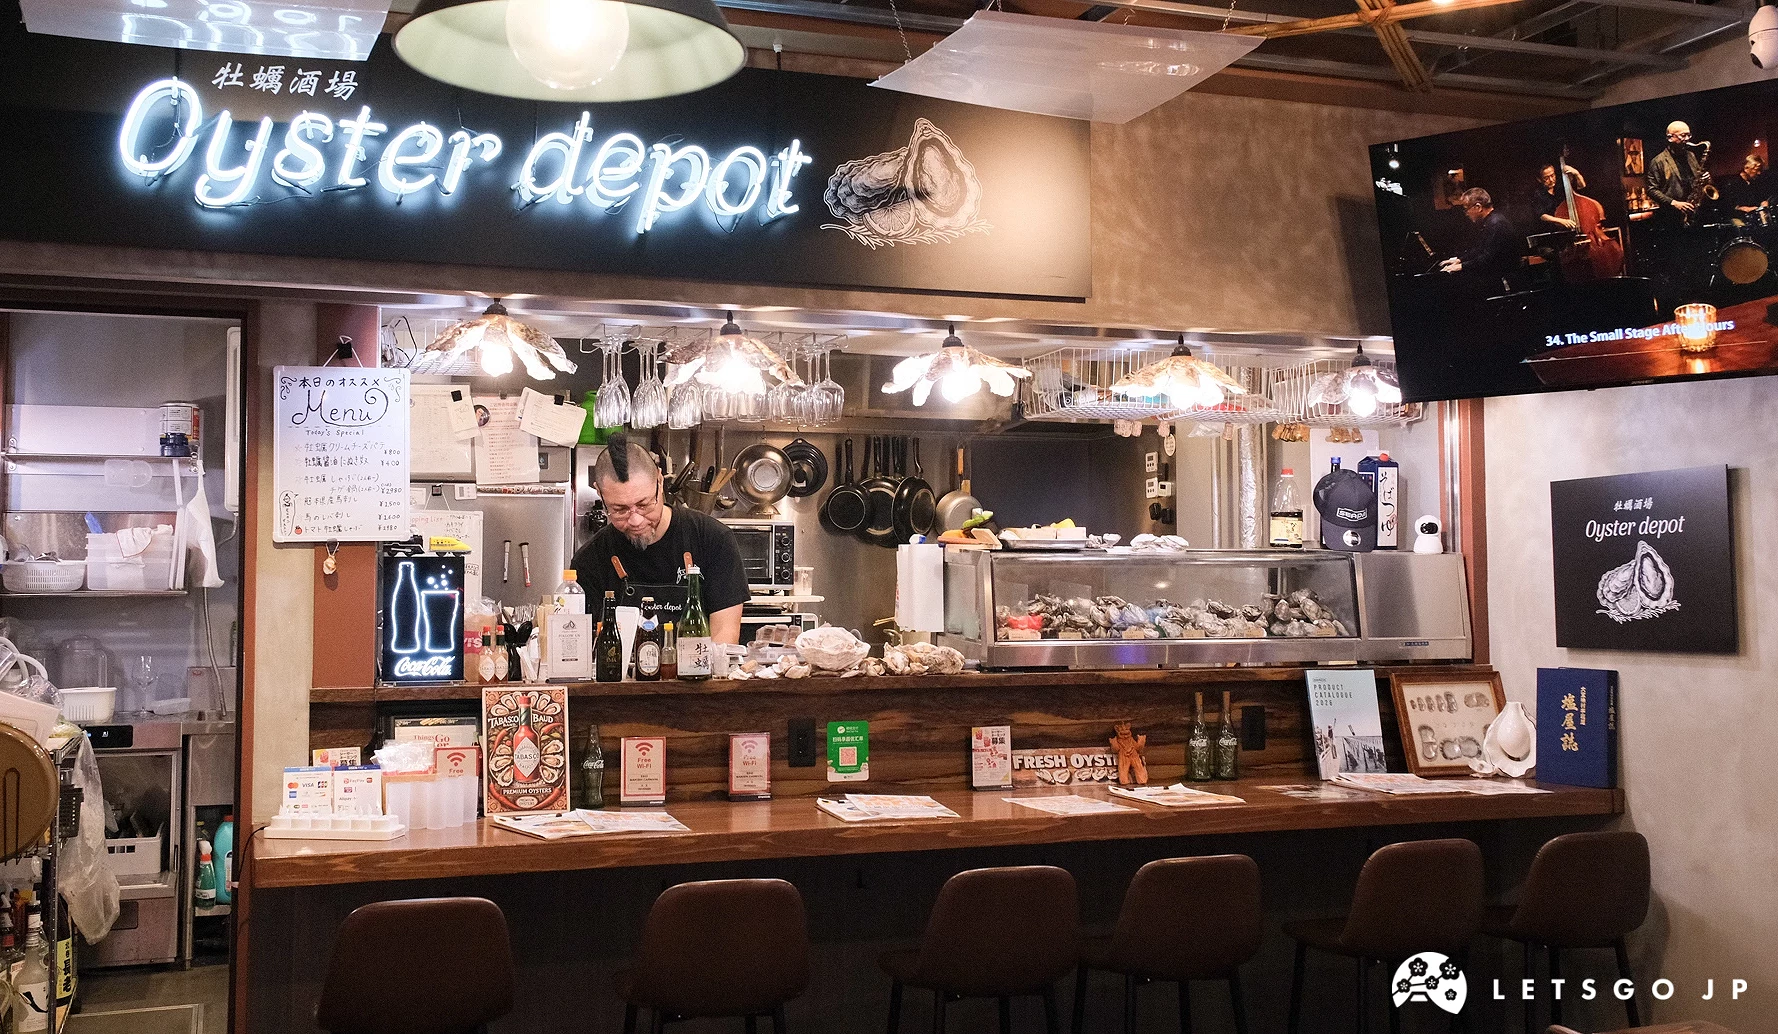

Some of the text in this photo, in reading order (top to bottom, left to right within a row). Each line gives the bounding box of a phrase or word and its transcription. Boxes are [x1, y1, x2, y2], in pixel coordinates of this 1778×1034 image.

[211, 62, 359, 101] 牡蠣酒場
[118, 77, 812, 235] Oyster depot
[1545, 335, 1565, 347] 34.
[1565, 332, 1589, 345] The
[1589, 328, 1623, 343] Small
[1625, 326, 1660, 340] Stage
[1662, 322, 1694, 336] Afte
[299, 376, 380, 389] 本日のオススメ
[292, 388, 388, 428] Menu
[305, 429, 364, 437] Today's Special
[1613, 497, 1653, 512] 牡蠣酒場
[1585, 515, 1685, 542] Oyster depot
[394, 656, 455, 677] Coca-Cola
[693, 642, 711, 670] 牡蠣
[488, 715, 520, 729] TABASCO
[1560, 693, 1579, 752] 塩屋誌
[435, 734, 451, 743] Go
[1012, 754, 1067, 769] FRESH
